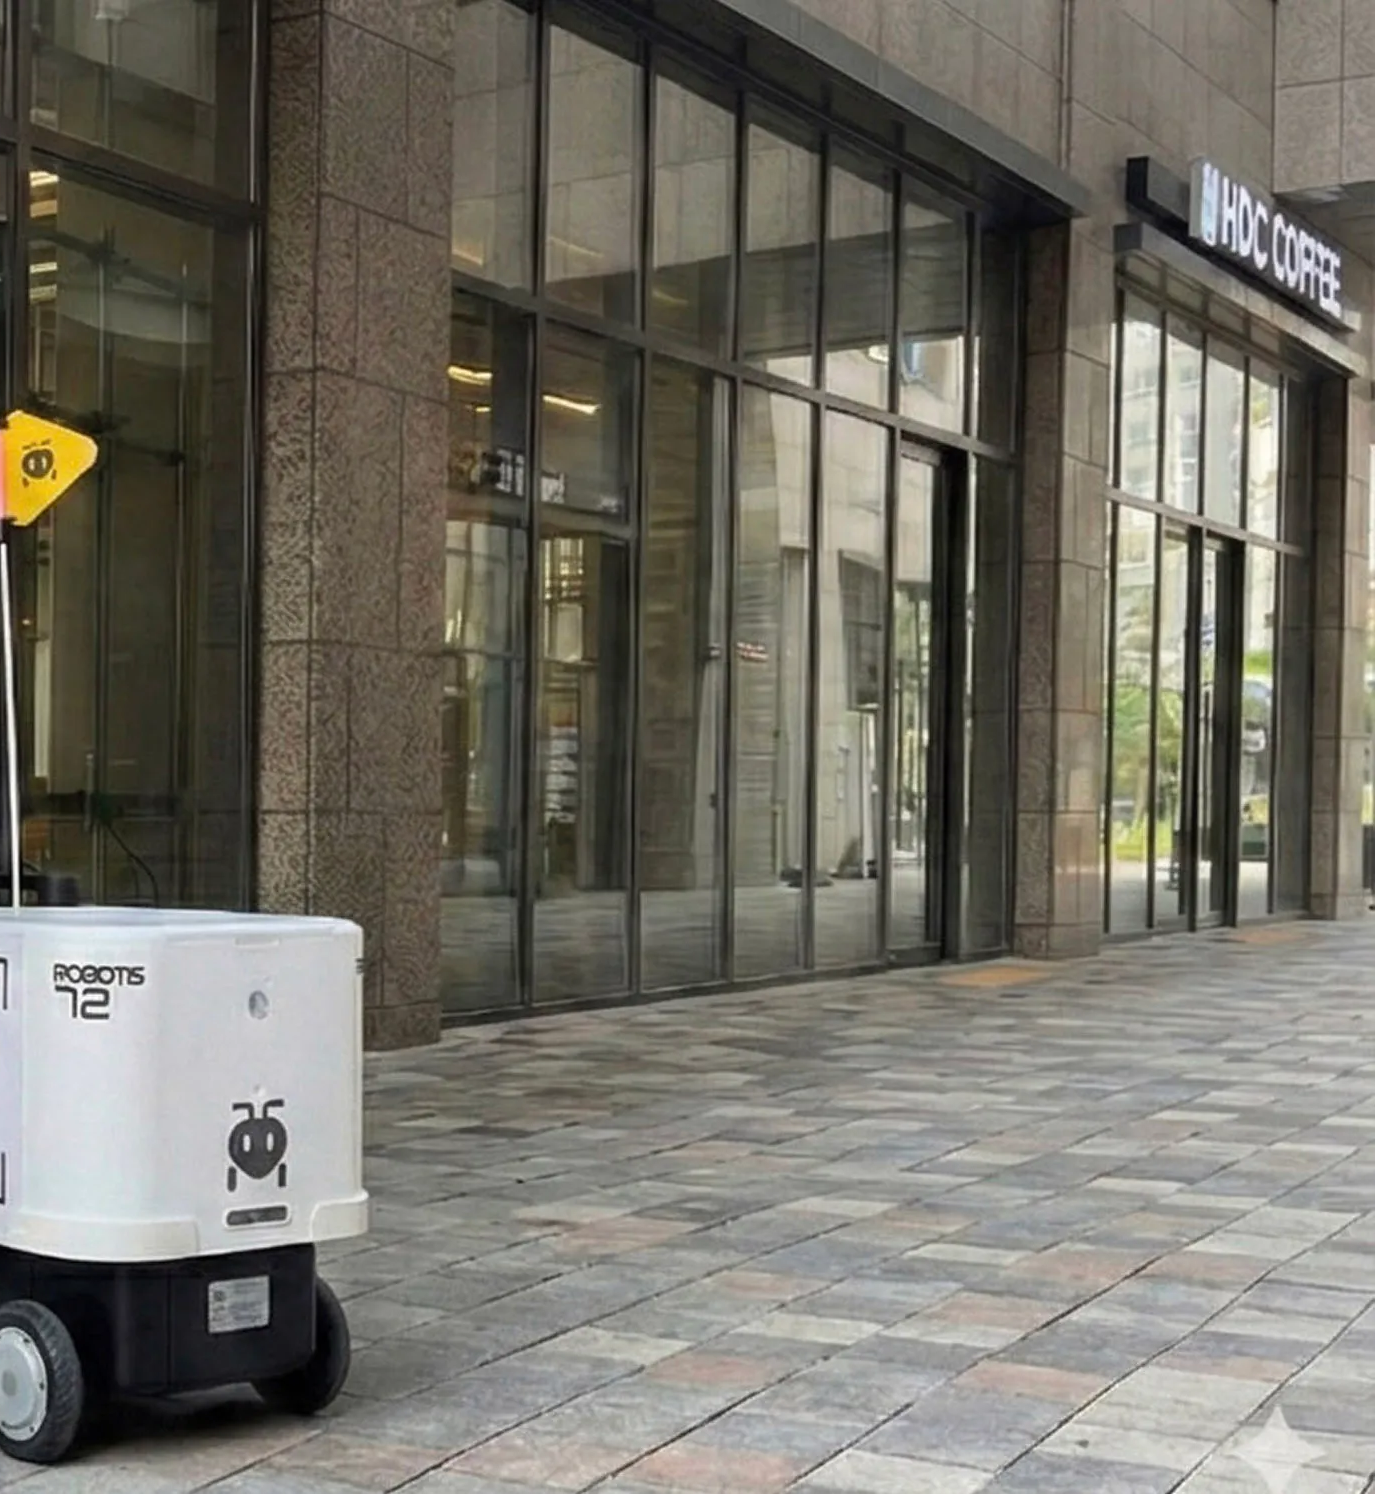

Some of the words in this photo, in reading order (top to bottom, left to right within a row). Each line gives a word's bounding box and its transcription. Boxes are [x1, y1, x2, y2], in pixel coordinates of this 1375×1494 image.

[1222, 176, 1268, 270] HDC
[1273, 213, 1342, 318] COFFEE
[53, 963, 146, 986] ROBOTIS
[55, 985, 110, 1020] 72
